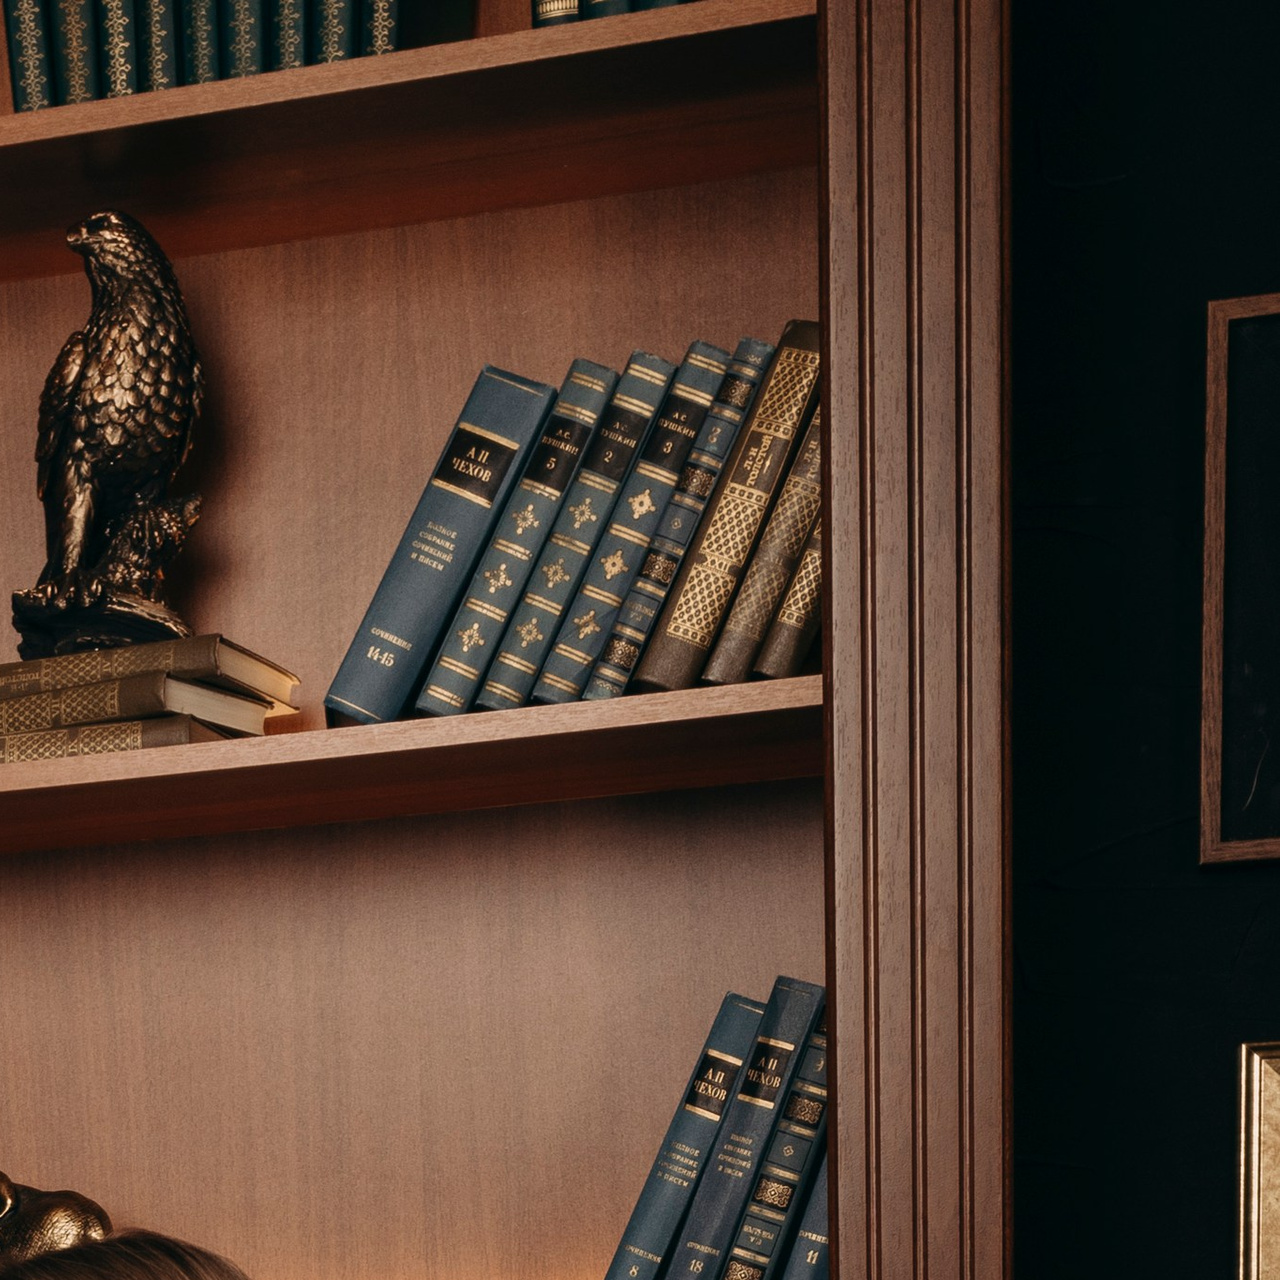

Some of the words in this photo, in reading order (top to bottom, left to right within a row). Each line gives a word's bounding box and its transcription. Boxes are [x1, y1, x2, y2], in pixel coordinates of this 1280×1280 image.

[660, 439, 674, 455] 3
[545, 456, 557, 471] 5
[602, 449, 614, 463] 2
[744, 432, 774, 489] ТОЛСТОЙ
[447, 456, 494, 486] ЧЕХОВ
[416, 554, 444, 572] ПИСЕМ
[365, 644, 397, 667] 14-15
[745, 1068, 782, 1089] ЧЕХОВ
[691, 1079, 728, 1102] ЧЕХОВ
[806, 1249, 820, 1265] 11
[629, 1265, 640, 1278] 8
[688, 1259, 704, 1274] 18
